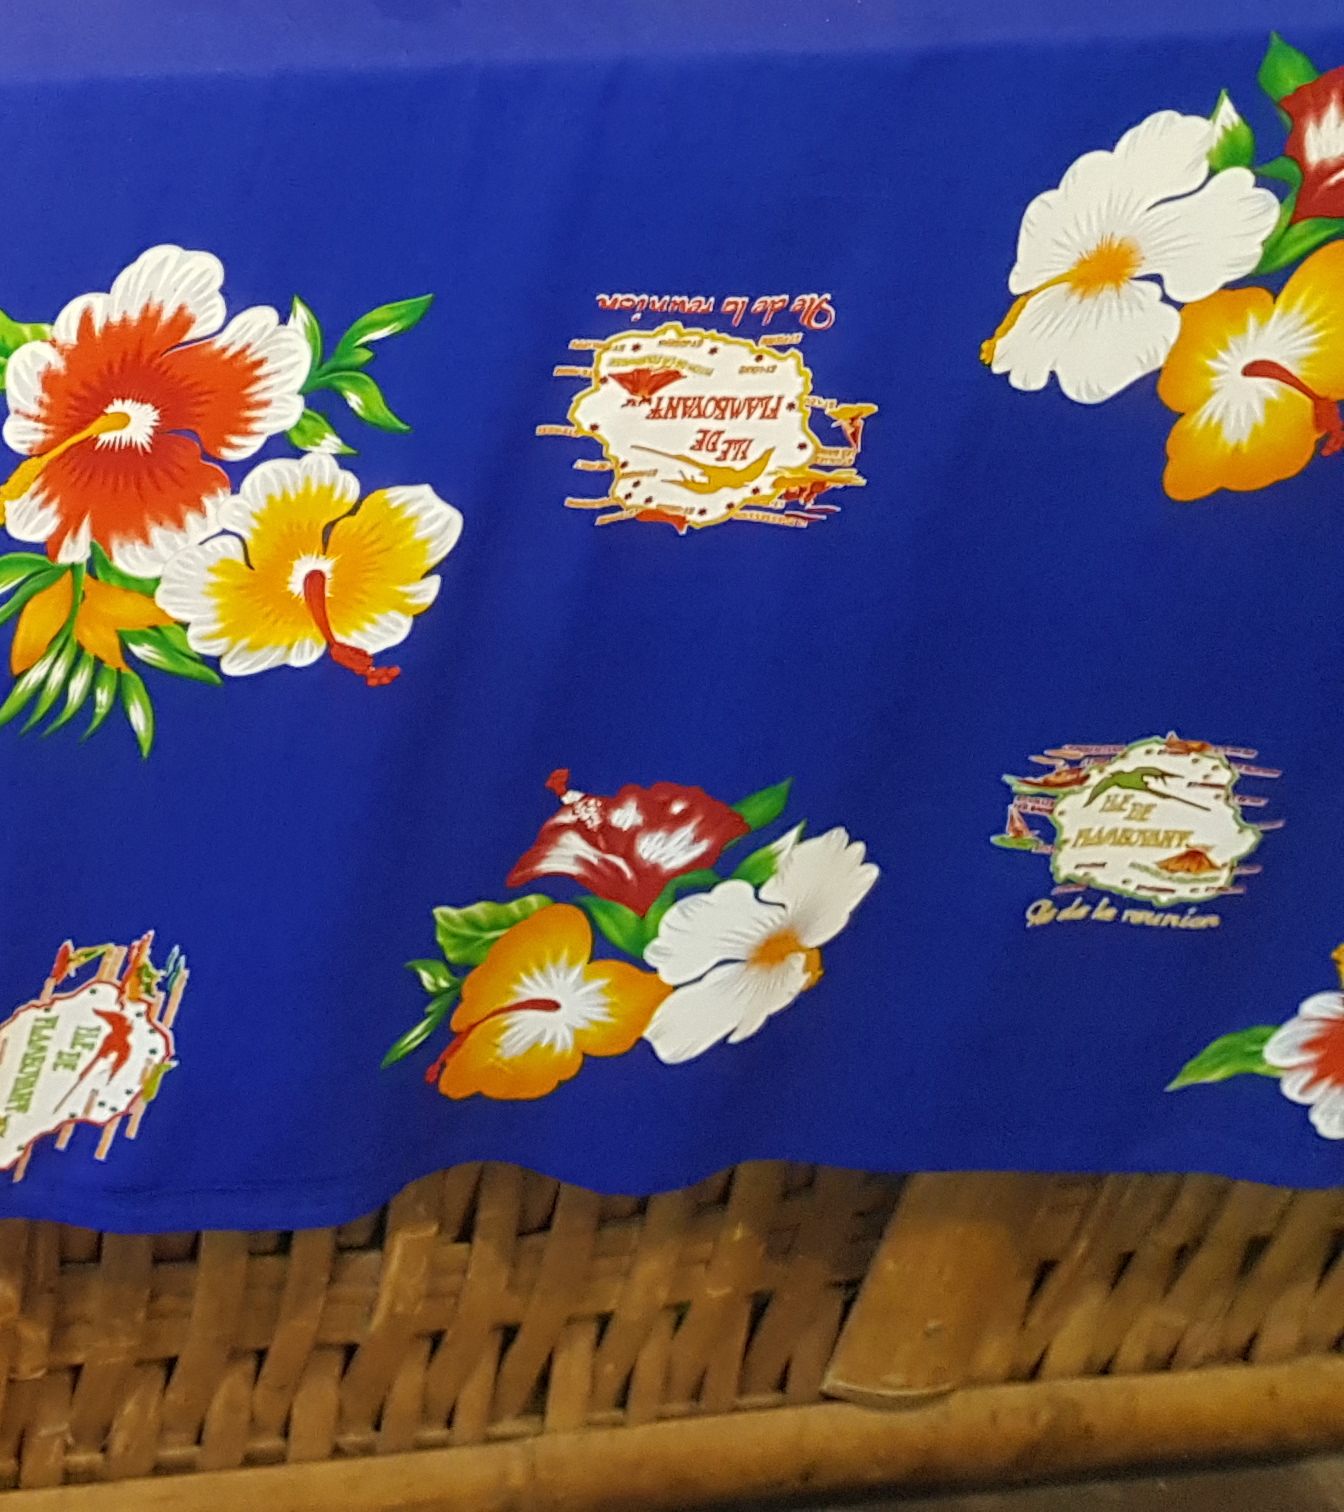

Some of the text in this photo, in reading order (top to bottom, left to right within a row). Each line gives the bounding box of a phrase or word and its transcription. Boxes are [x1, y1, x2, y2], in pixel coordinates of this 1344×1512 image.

[596, 293, 715, 323] reunion
[721, 295, 749, 326] la
[752, 294, 787, 326] de
[645, 395, 785, 420] FLAMBOYANT
[690, 429, 753, 462] ILE DE
